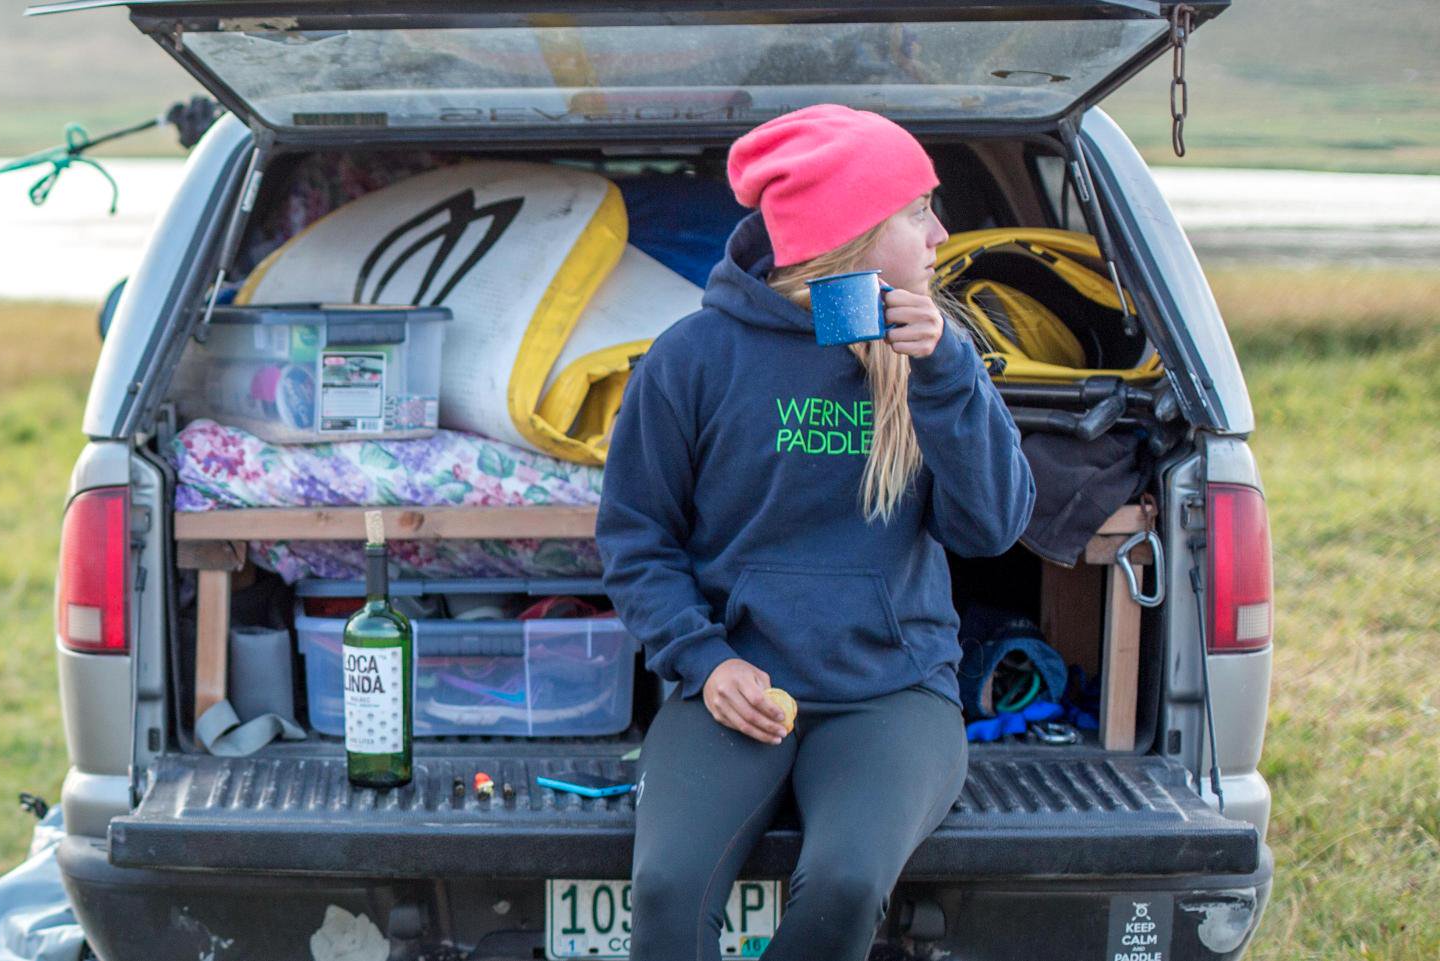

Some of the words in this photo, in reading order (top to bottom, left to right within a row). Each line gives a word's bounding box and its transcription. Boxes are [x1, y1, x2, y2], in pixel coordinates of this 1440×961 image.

[1125, 922, 1156, 933] KEEP
[1121, 934, 1158, 945] CALM
[1114, 952, 1162, 961] PADDLE
